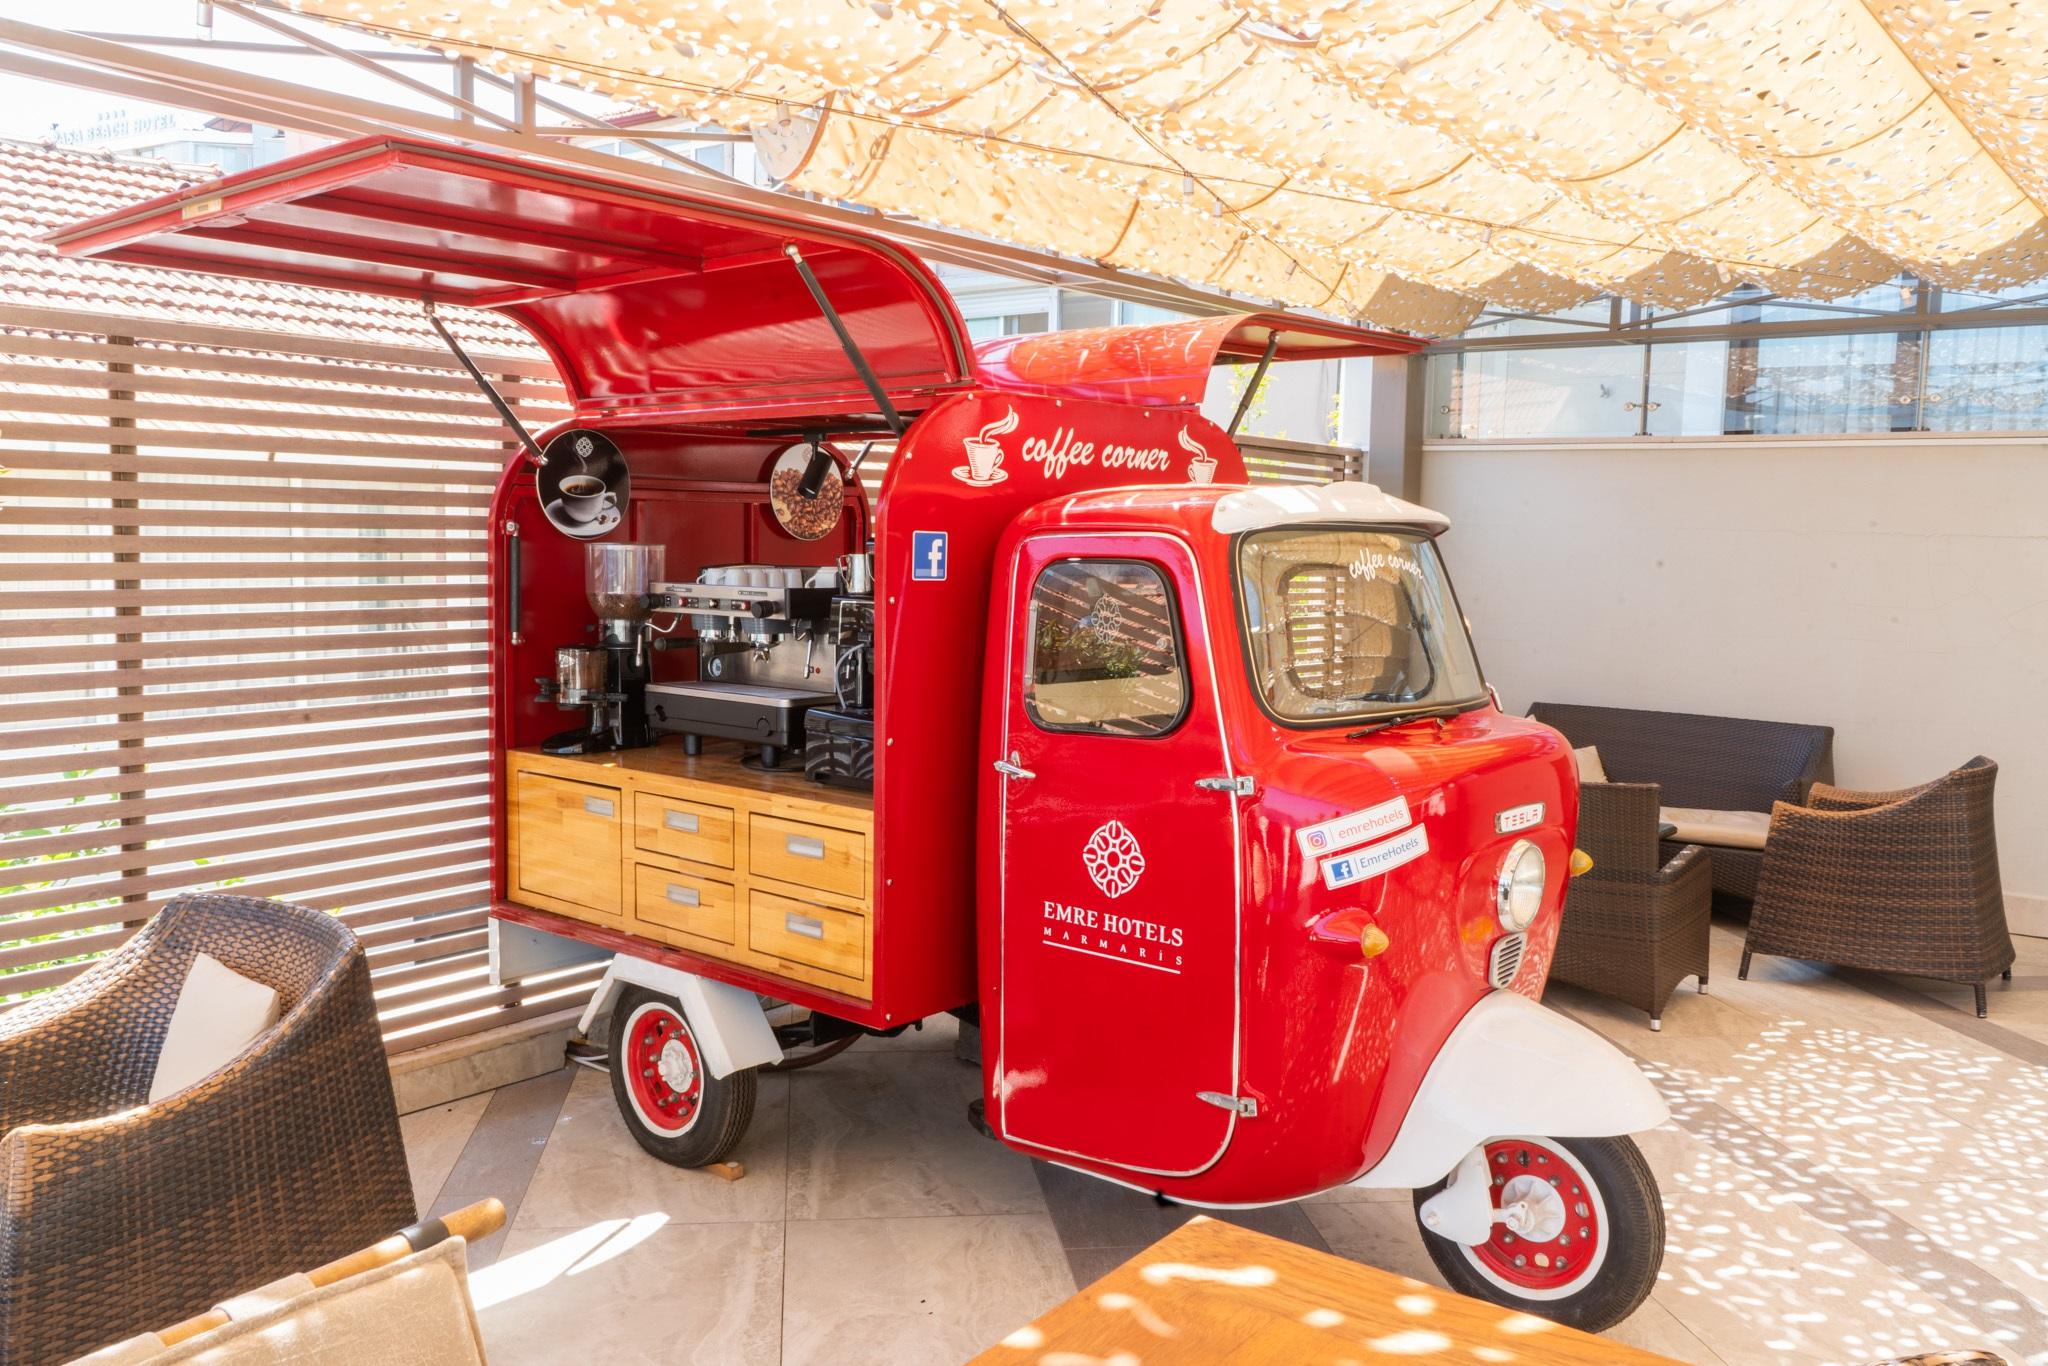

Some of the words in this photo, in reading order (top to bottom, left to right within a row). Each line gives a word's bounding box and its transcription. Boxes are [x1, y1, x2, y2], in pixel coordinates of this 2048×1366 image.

[87, 121, 129, 140] BEACH
[134, 113, 177, 132] HOTEL
[1022, 426, 1095, 480] coffee
[1101, 443, 1171, 472] corner
[1348, 547, 1385, 582] coffee
[1387, 553, 1424, 580] corner
[1338, 808, 1405, 840] emrehotels
[1503, 808, 1539, 828] TESLA
[1359, 836, 1420, 869] EmreHotels
[1043, 900, 1098, 929] EMRE
[1103, 913, 1184, 948] HOTELS
